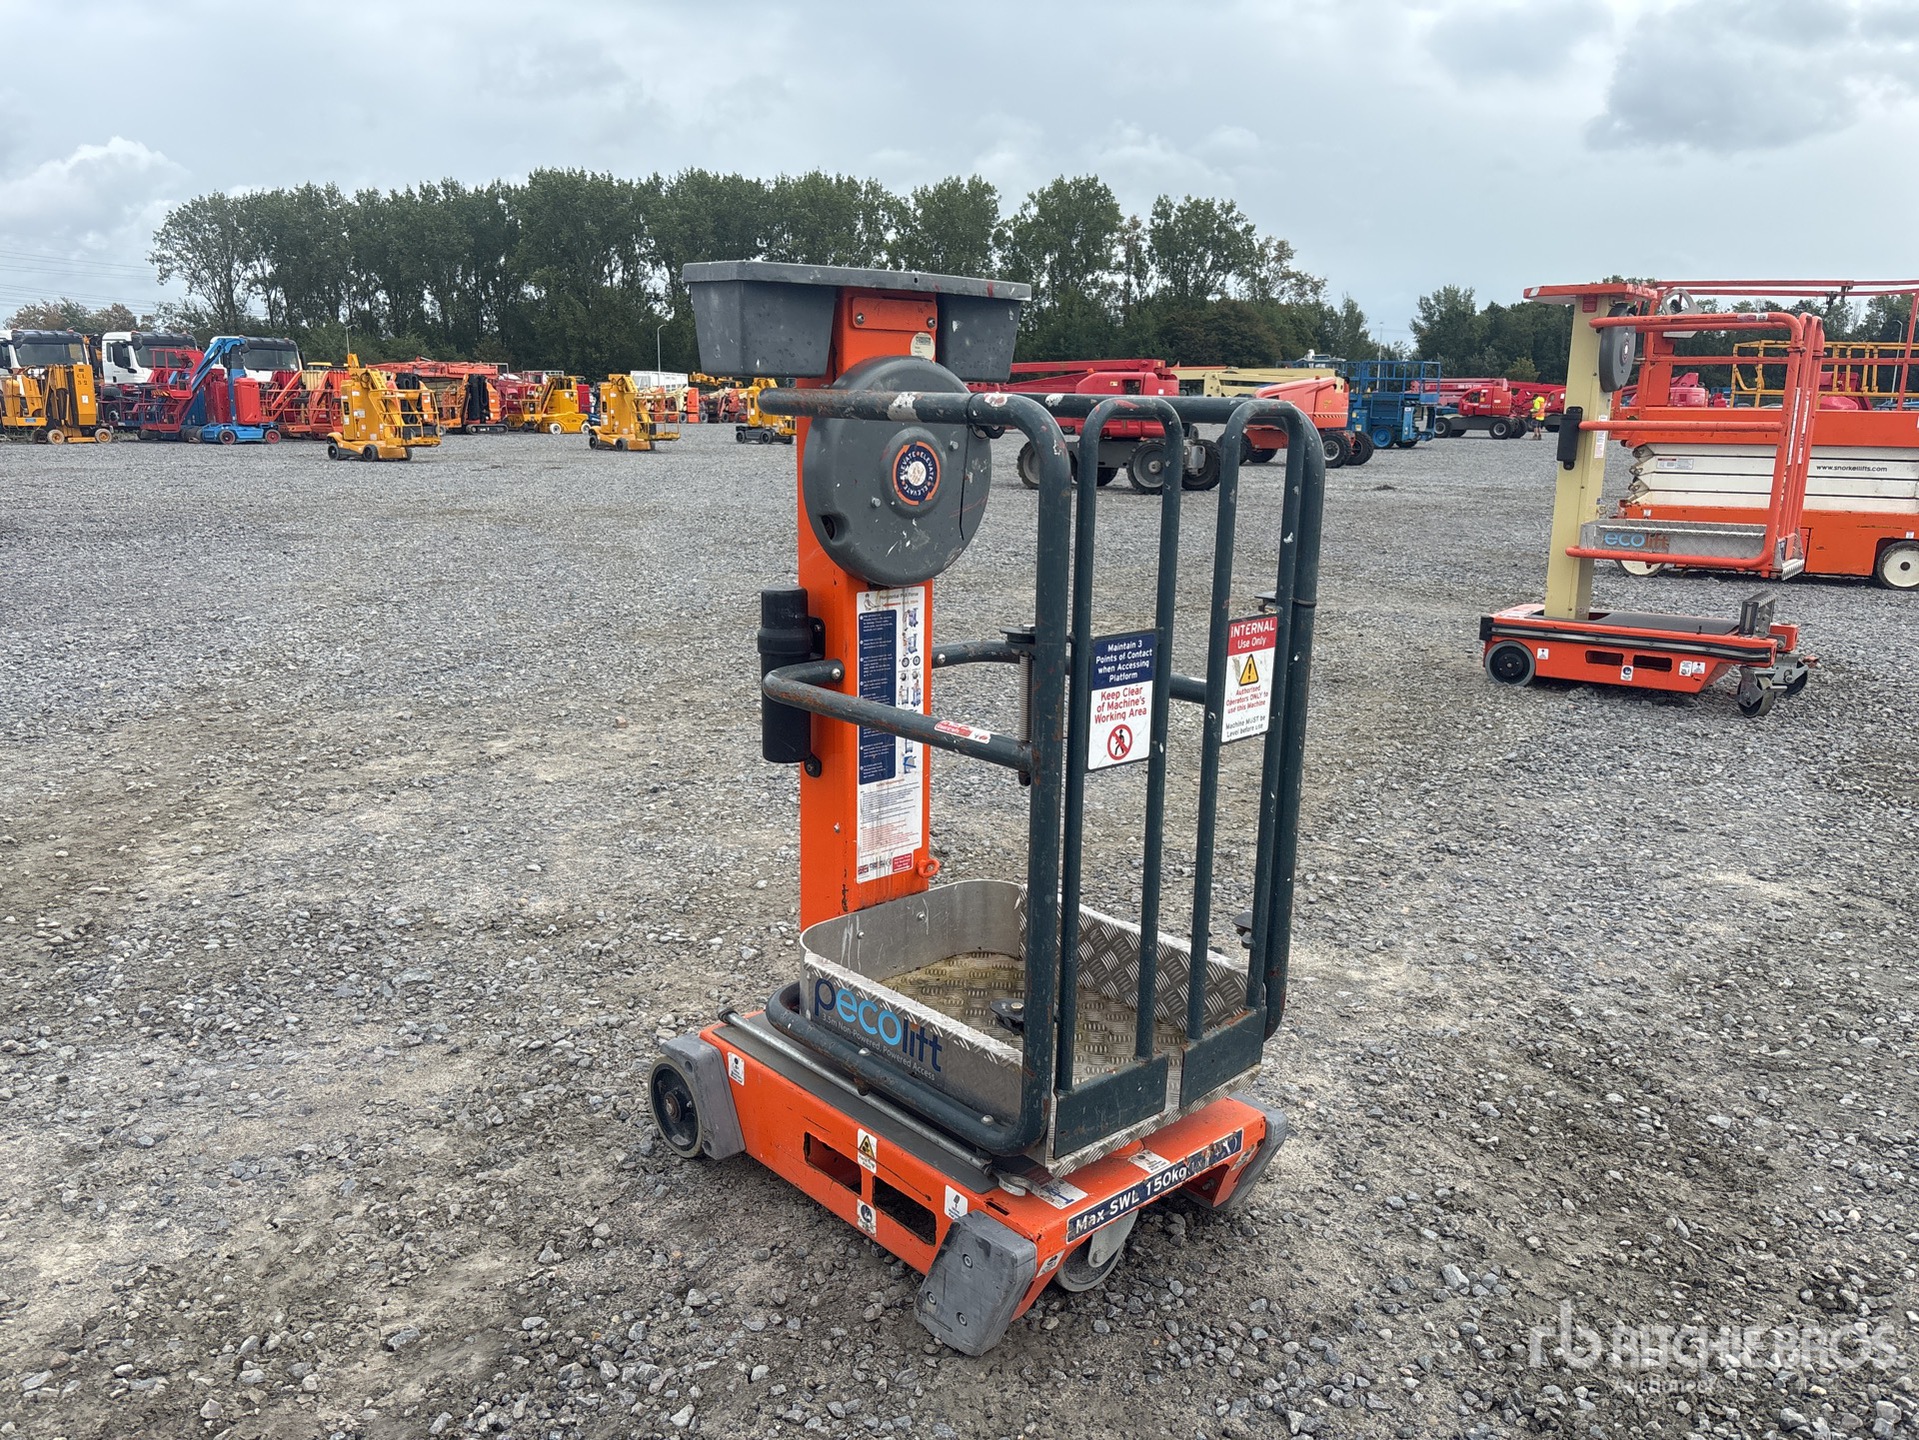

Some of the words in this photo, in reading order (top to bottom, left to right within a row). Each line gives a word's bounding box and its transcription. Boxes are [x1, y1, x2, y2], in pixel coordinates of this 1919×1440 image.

[920, 452, 934, 480] ELEVATE
[1230, 620, 1274, 638] INTERNAL
[1108, 642, 1136, 652] Maintain
[1138, 640, 1142, 648] 3
[1238, 640, 1250, 649] Use
[1252, 636, 1267, 646] Only
[1096, 654, 1117, 664] Points
[1118, 652, 1126, 660] of
[1127, 648, 1152, 660] Contact
[1098, 665, 1116, 674] when
[1117, 660, 1150, 671] Accessing
[1108, 672, 1138, 682] Platform
[1100, 691, 1120, 701] Keep
[1122, 686, 1143, 698] Clear
[1236, 686, 1261, 696] Authorised
[1096, 702, 1106, 713] of
[1107, 697, 1146, 711] Machine's
[1226, 696, 1248, 706] Operators
[1250, 692, 1262, 700] ONLY
[1237, 703, 1246, 712] this
[1247, 700, 1266, 708] Machine
[1094, 711, 1126, 724] Working
[1128, 708, 1147, 718] Area
[1226, 720, 1244, 730] Machine
[1246, 716, 1259, 726] MUST
[1226, 728, 1239, 738] Level
[1240, 724, 1254, 734] before
[814, 978, 942, 1072] pecolift
[822, 1012, 838, 1026] 3.5m
[882, 1045, 912, 1067] Powered
[912, 1062, 936, 1081] Access
[1076, 1210, 1105, 1234] Max
[1109, 1190, 1140, 1216] SWL
